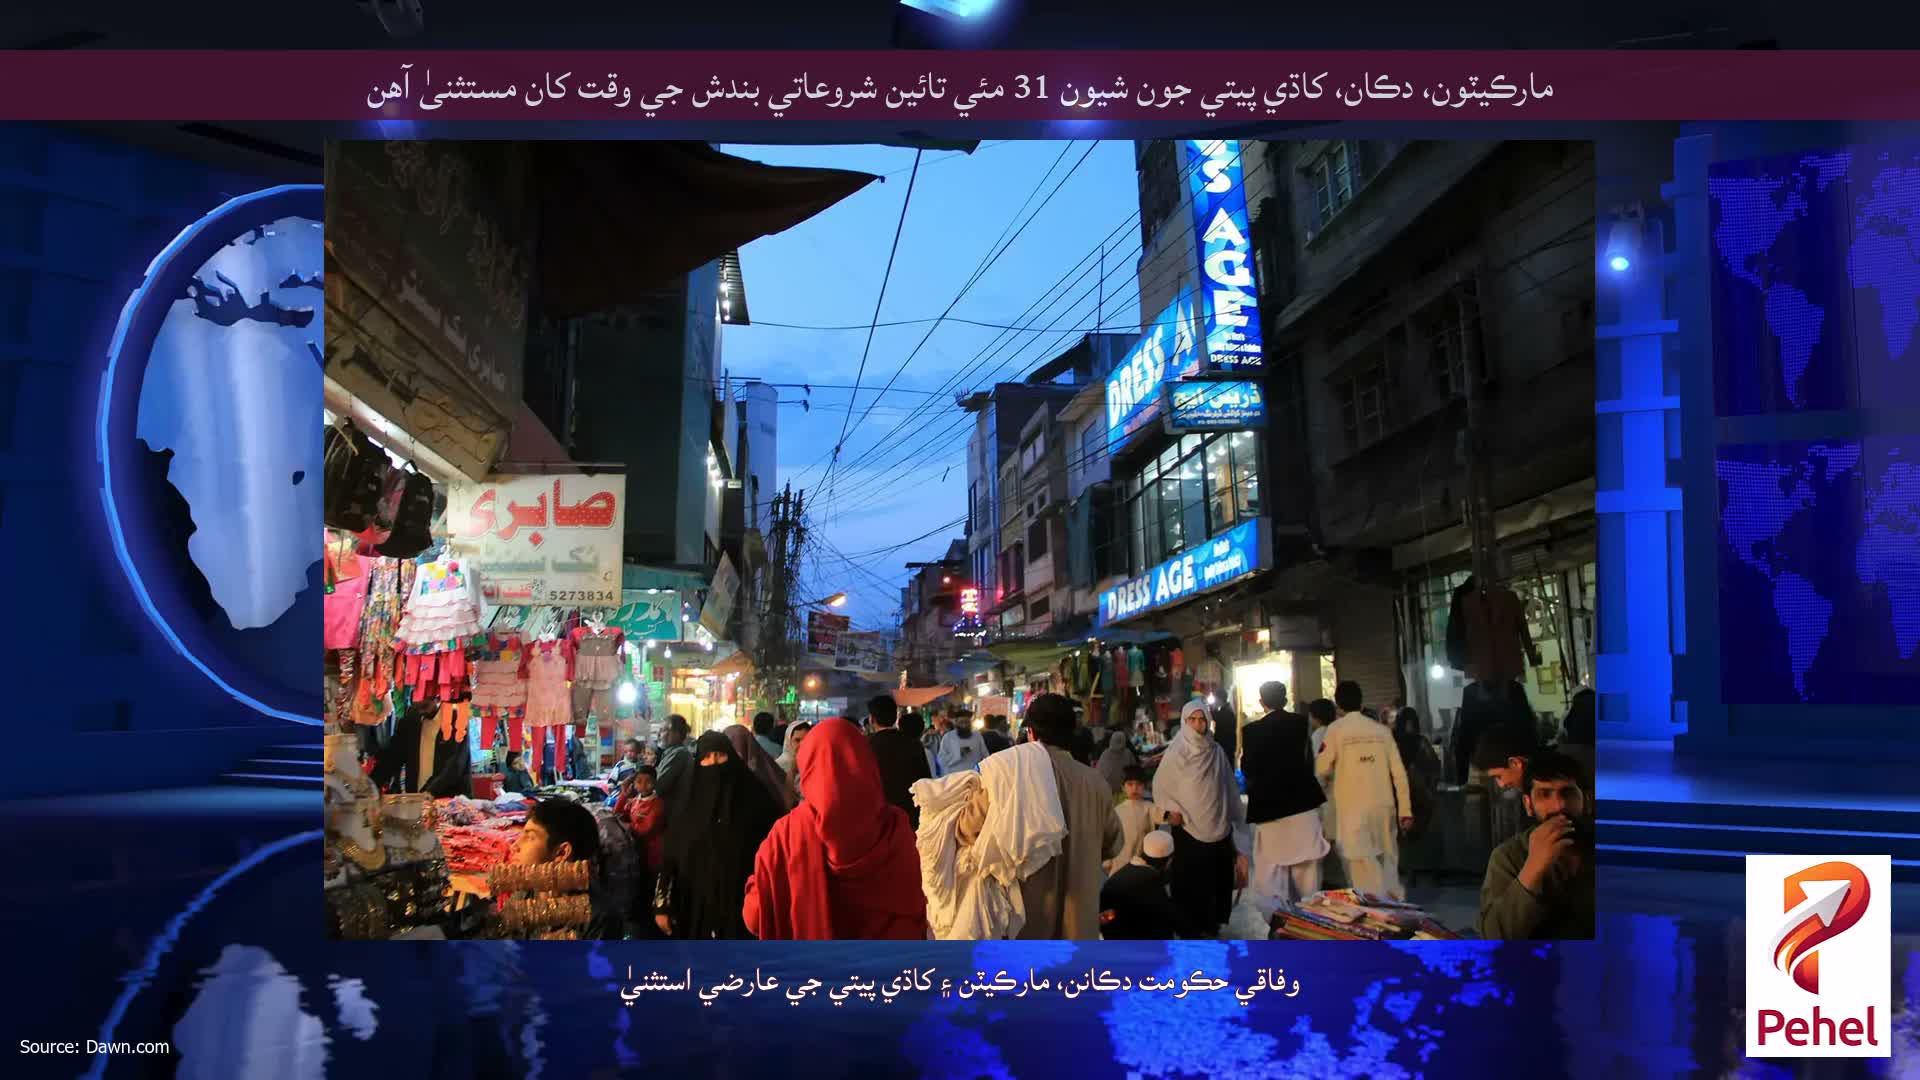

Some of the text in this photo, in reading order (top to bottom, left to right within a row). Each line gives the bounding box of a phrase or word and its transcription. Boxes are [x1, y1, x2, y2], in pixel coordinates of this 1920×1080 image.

[1203, 207, 1257, 327] AGE
[1108, 325, 1166, 430] DRESS
[1172, 302, 1197, 367] A
[1210, 353, 1239, 364] DRESS
[465, 479, 617, 545] صابری
[549, 590, 614, 601] 5273834
[1107, 574, 1152, 620] DRESS
[1155, 554, 1195, 602] AGE
